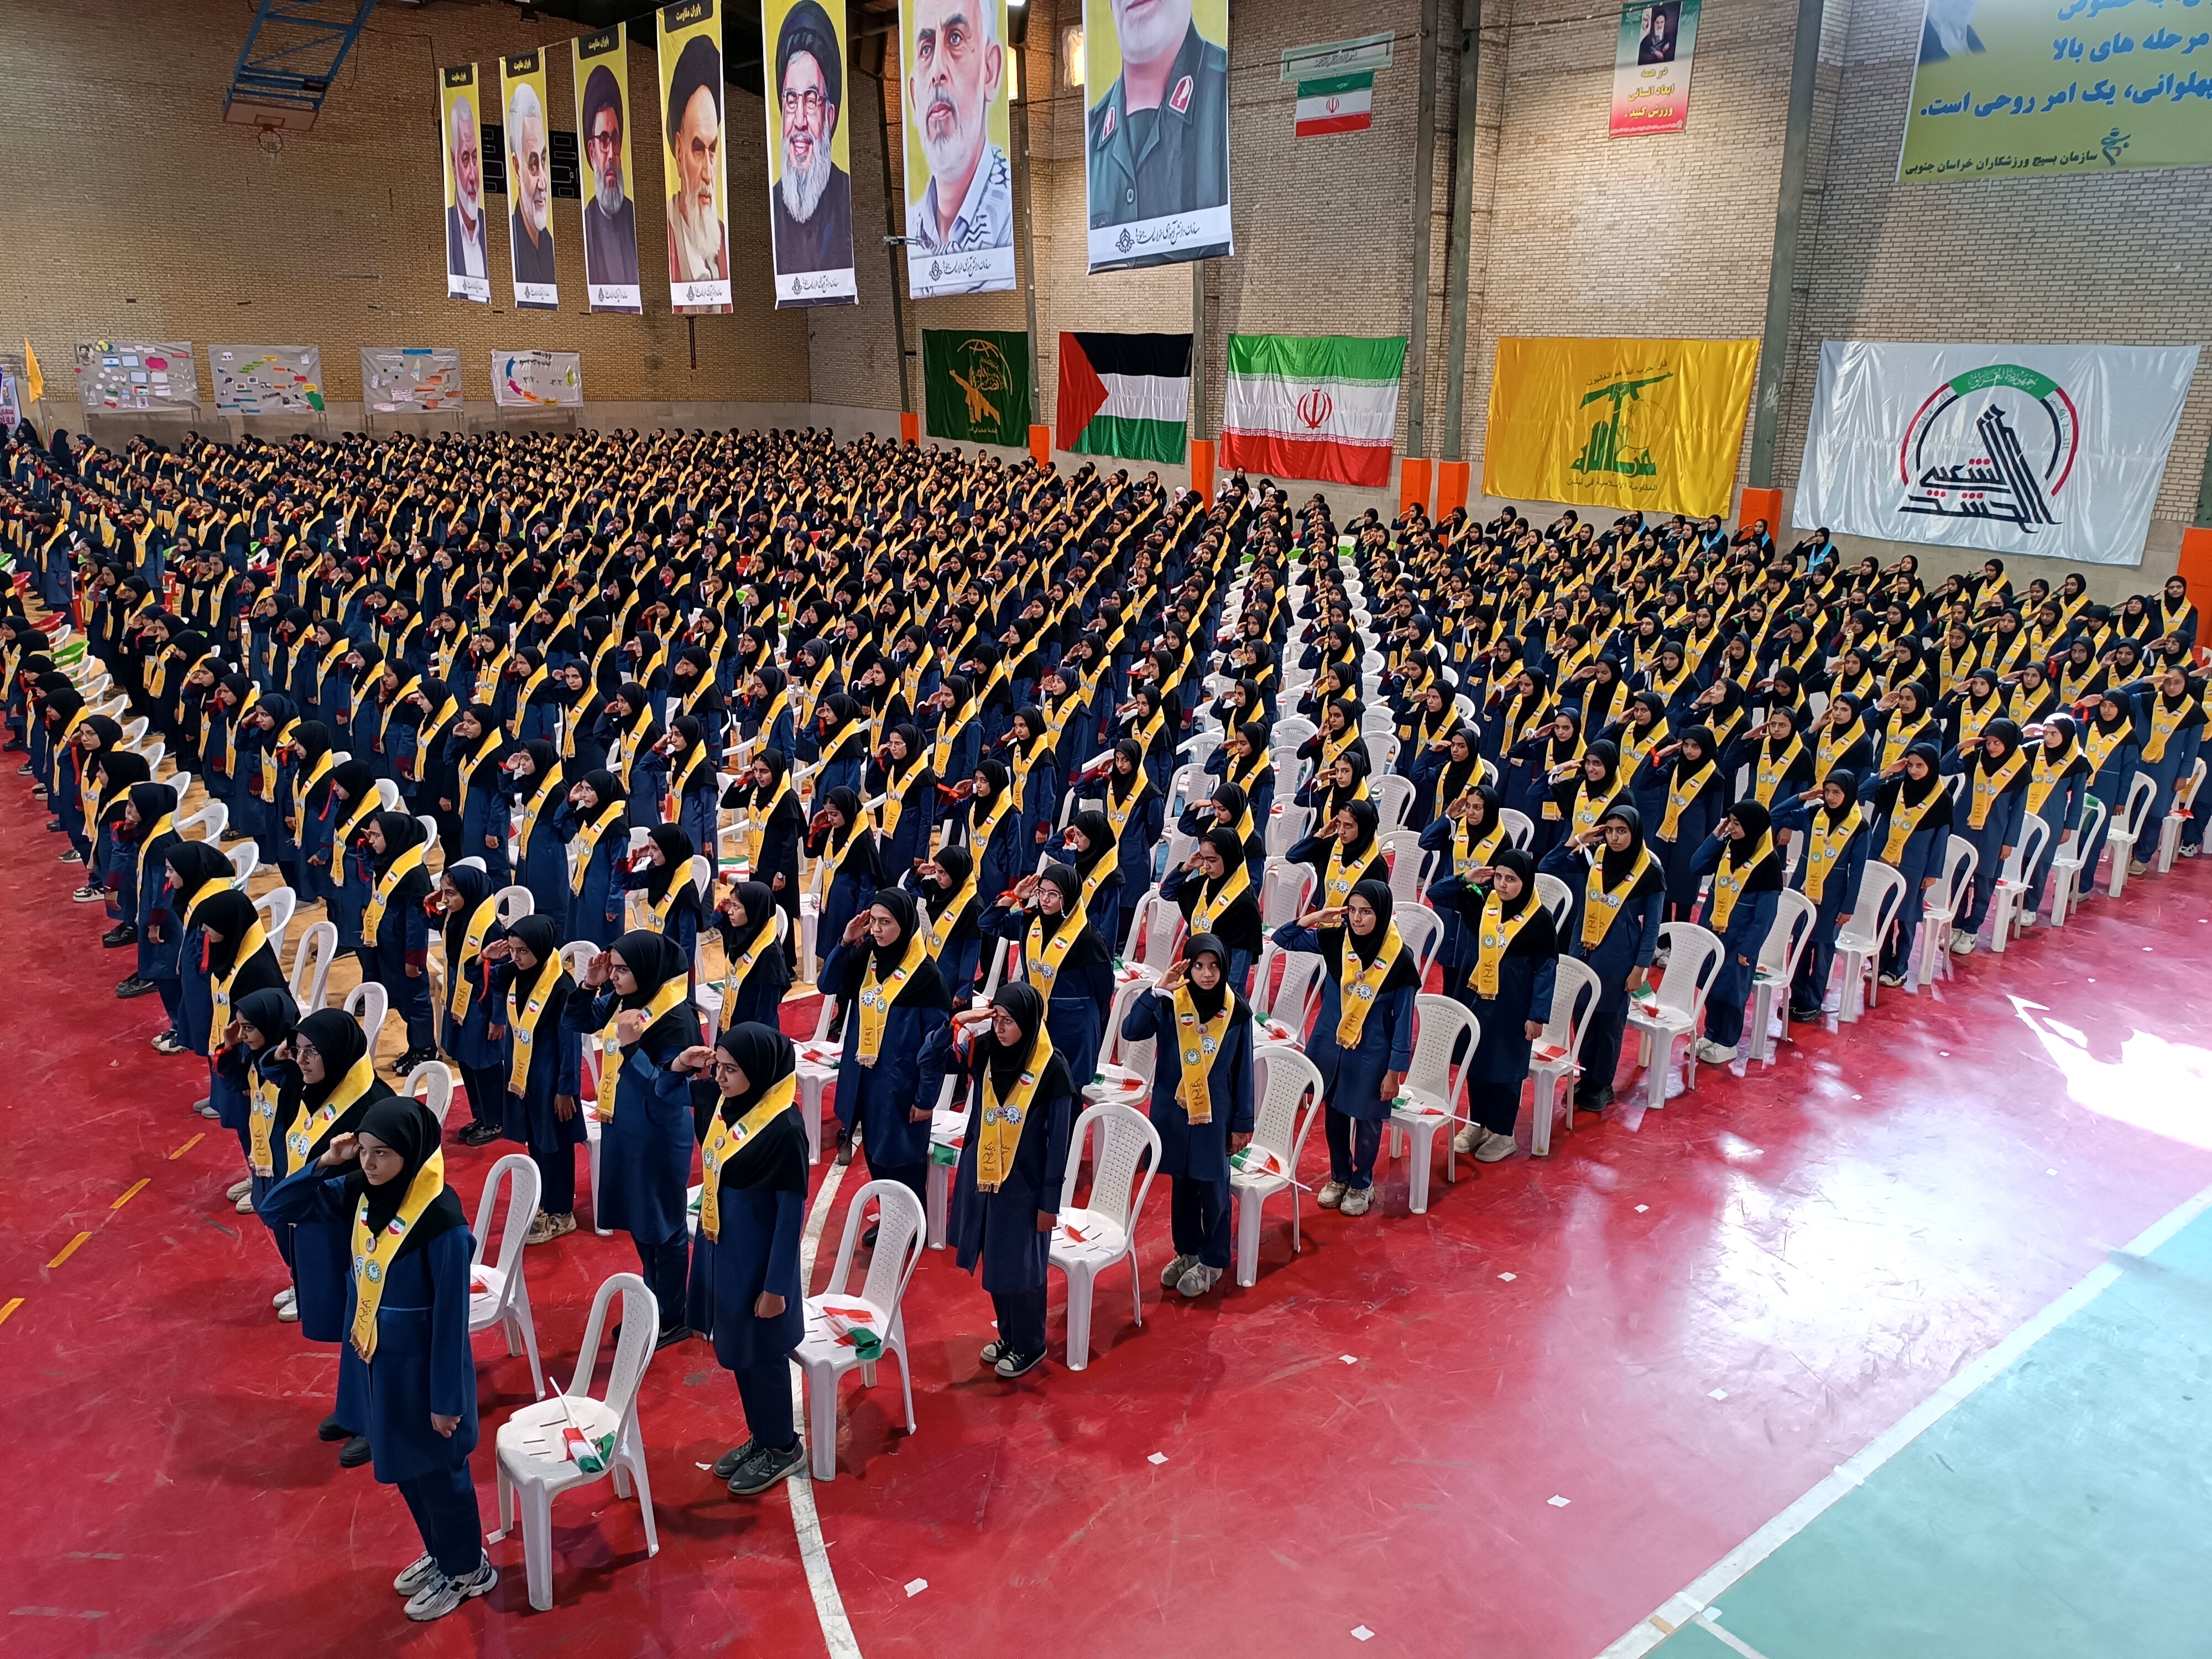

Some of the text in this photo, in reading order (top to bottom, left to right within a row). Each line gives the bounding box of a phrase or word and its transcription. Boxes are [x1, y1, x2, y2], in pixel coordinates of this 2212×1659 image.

[2053, 27, 2210, 63] مرحله های بالا
[1657, 67, 1668, 79] در
[1655, 83, 1675, 96] ابعاد
[2041, 81, 2077, 112] امر
[2082, 79, 2116, 105] یک
[1647, 106, 1673, 119] ورزش
[1974, 95, 2035, 117] روحی
[1905, 149, 2098, 175] سازمان بسیج ورزشکاران خراسان جنوبی
